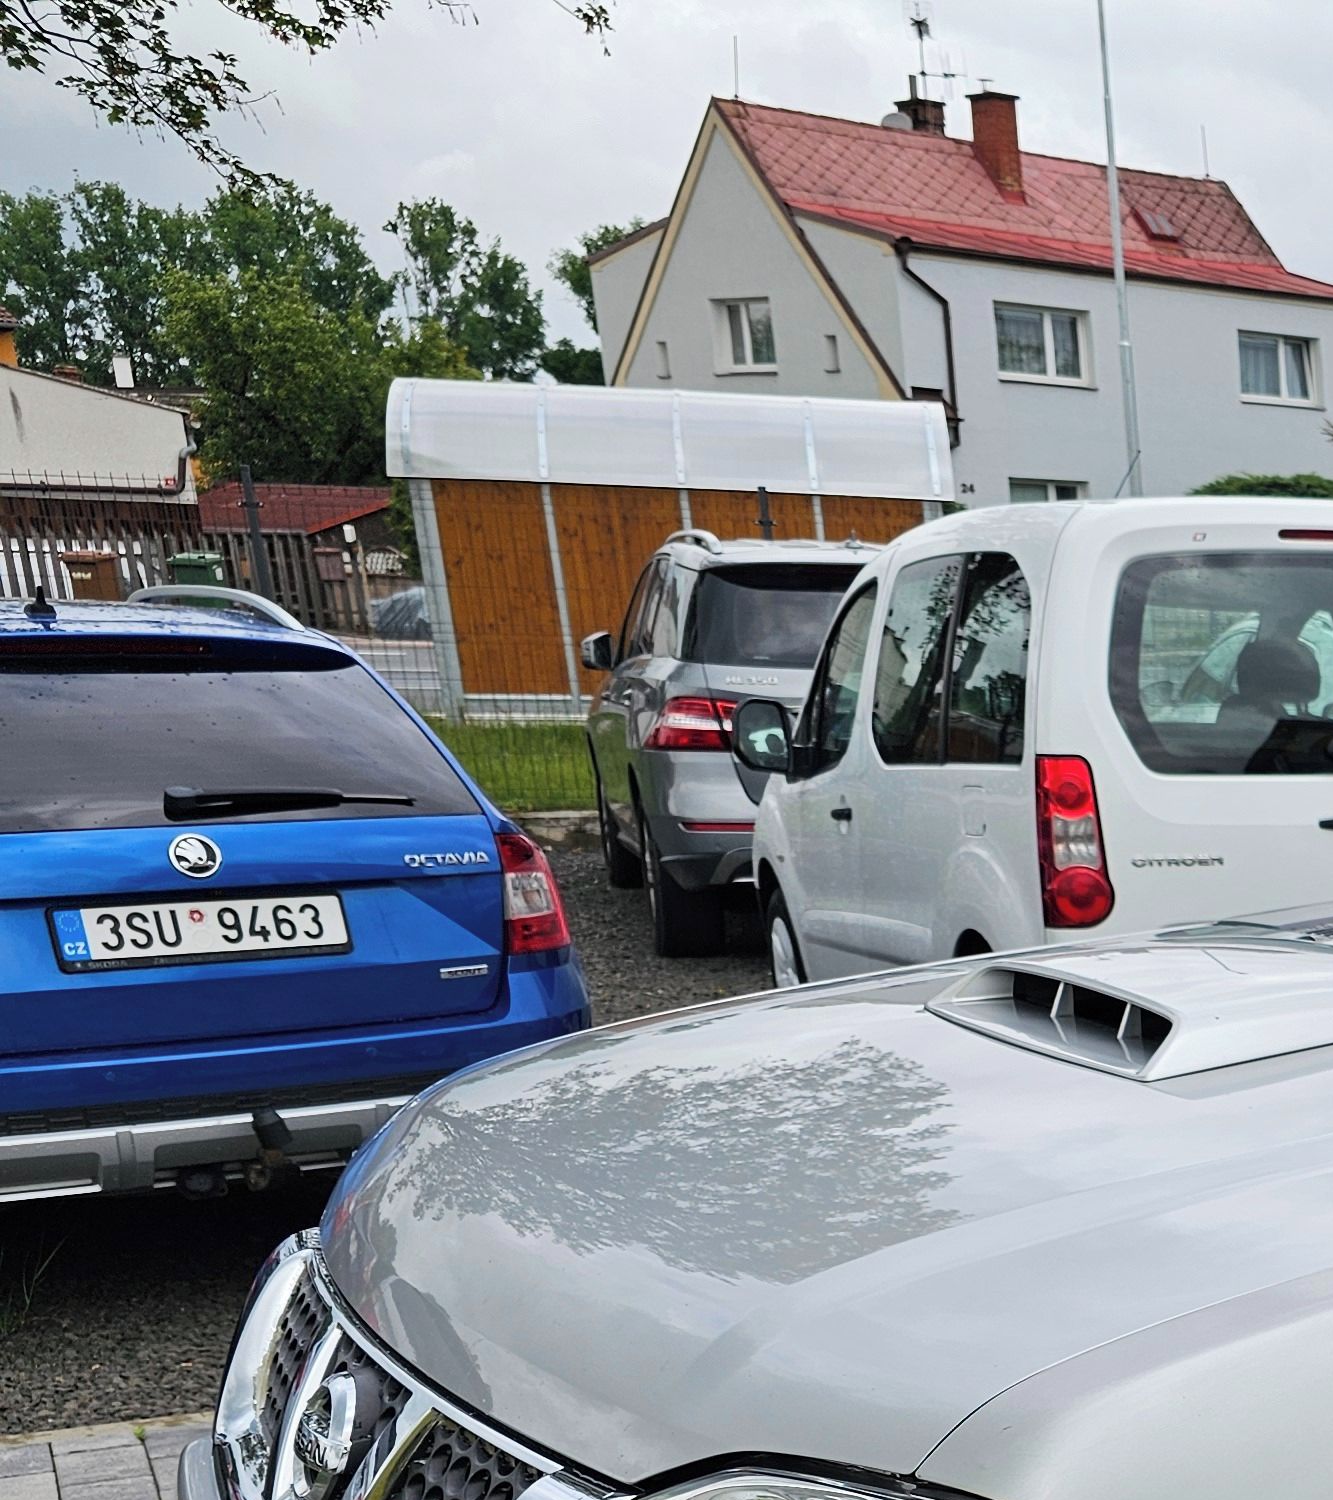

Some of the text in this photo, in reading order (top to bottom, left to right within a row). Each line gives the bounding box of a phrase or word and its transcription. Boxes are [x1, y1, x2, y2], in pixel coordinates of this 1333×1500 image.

[404, 852, 490, 867] OCTAVIA
[96, 904, 324, 951] 3SU 9463
[64, 941, 87, 955] CZ
